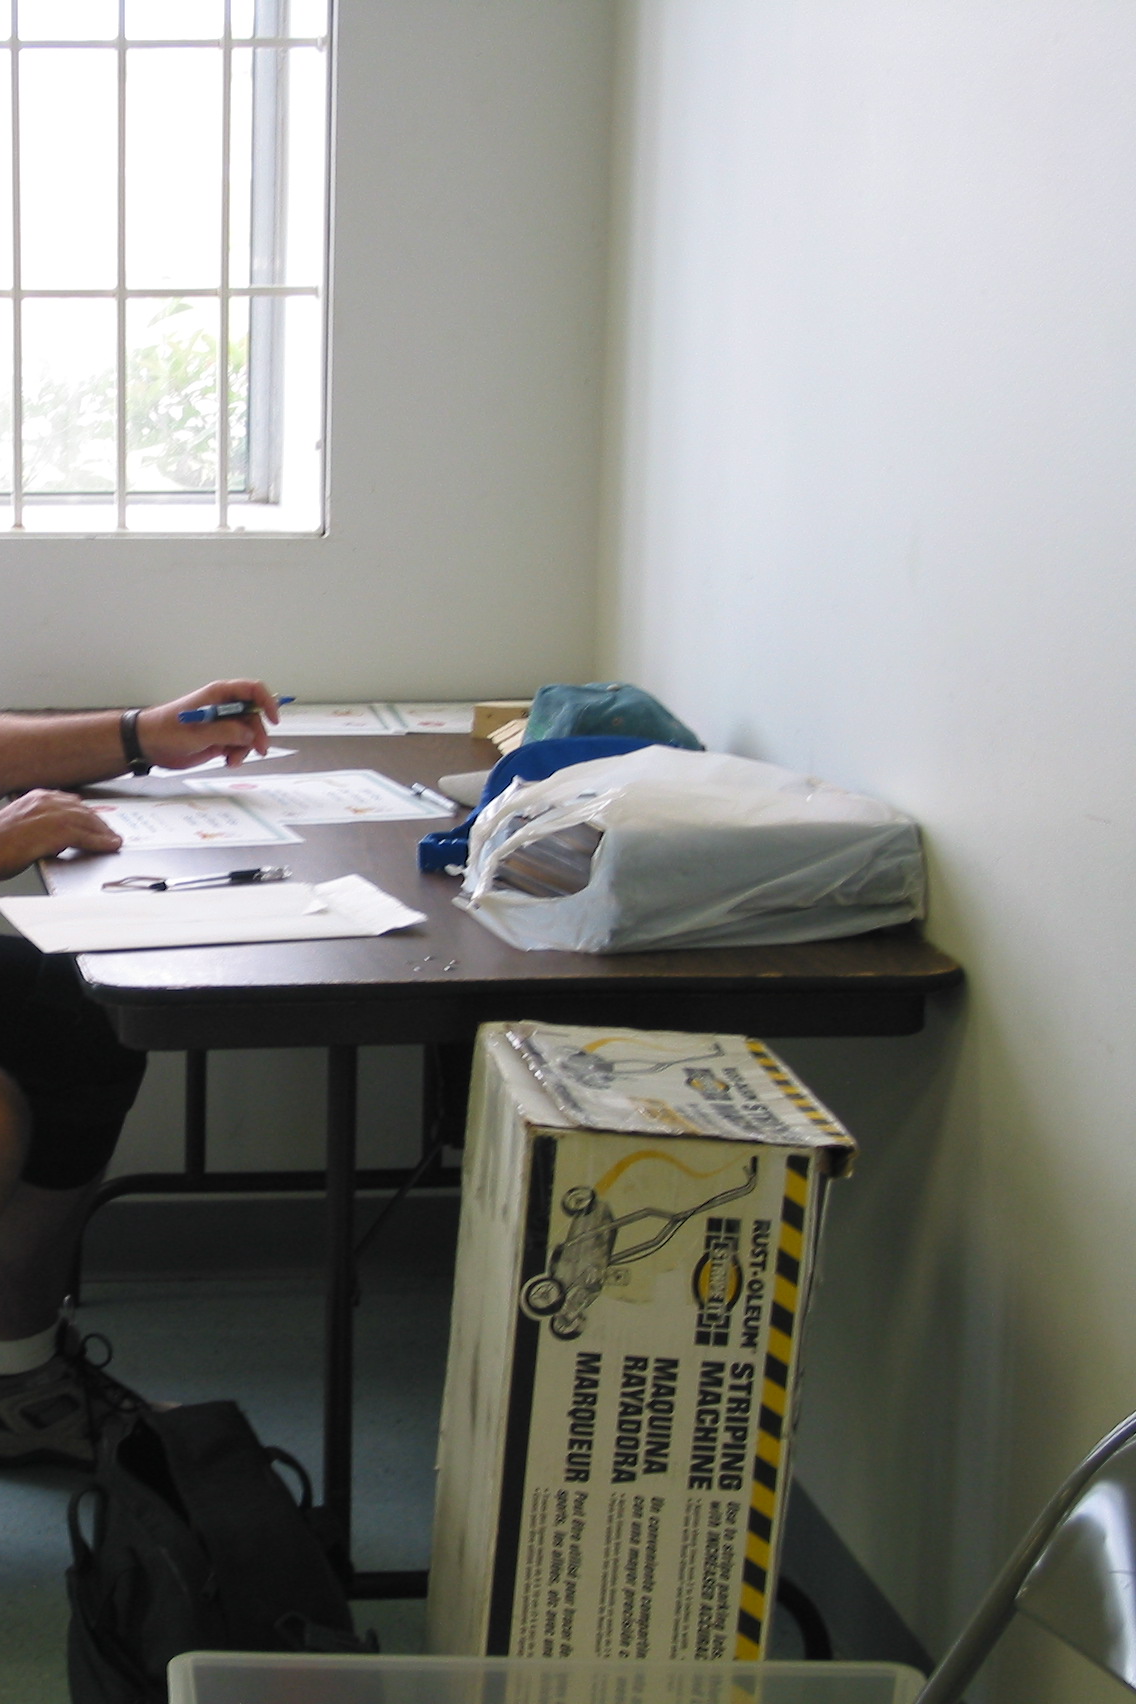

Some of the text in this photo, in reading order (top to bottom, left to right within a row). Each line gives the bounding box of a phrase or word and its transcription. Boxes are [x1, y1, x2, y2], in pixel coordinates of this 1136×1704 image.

[564, 1352, 601, 1483] MARQUEUR
[611, 1355, 648, 1484] RAYADORA
[642, 1357, 679, 1476] MAQUINA
[688, 1360, 725, 1490] MACHINE
[718, 1361, 754, 1492] STRIPING
[573, 1491, 589, 1517] Peut
[633, 1495, 645, 1519] con
[650, 1497, 666, 1513] Un
[708, 1501, 722, 1528] with
[726, 1501, 741, 1525] Use
[629, 1521, 643, 1545] una
[724, 1529, 738, 1541] to
[624, 1548, 640, 1586] mayor
[642, 1516, 660, 1593] conveniente
[702, 1531, 721, 1601] INCREASED
[719, 1544, 735, 1581] stripe
[564, 1580, 576, 1605] pour
[714, 1583, 730, 1631] parking
[544, 1611, 557, 1636] avec
